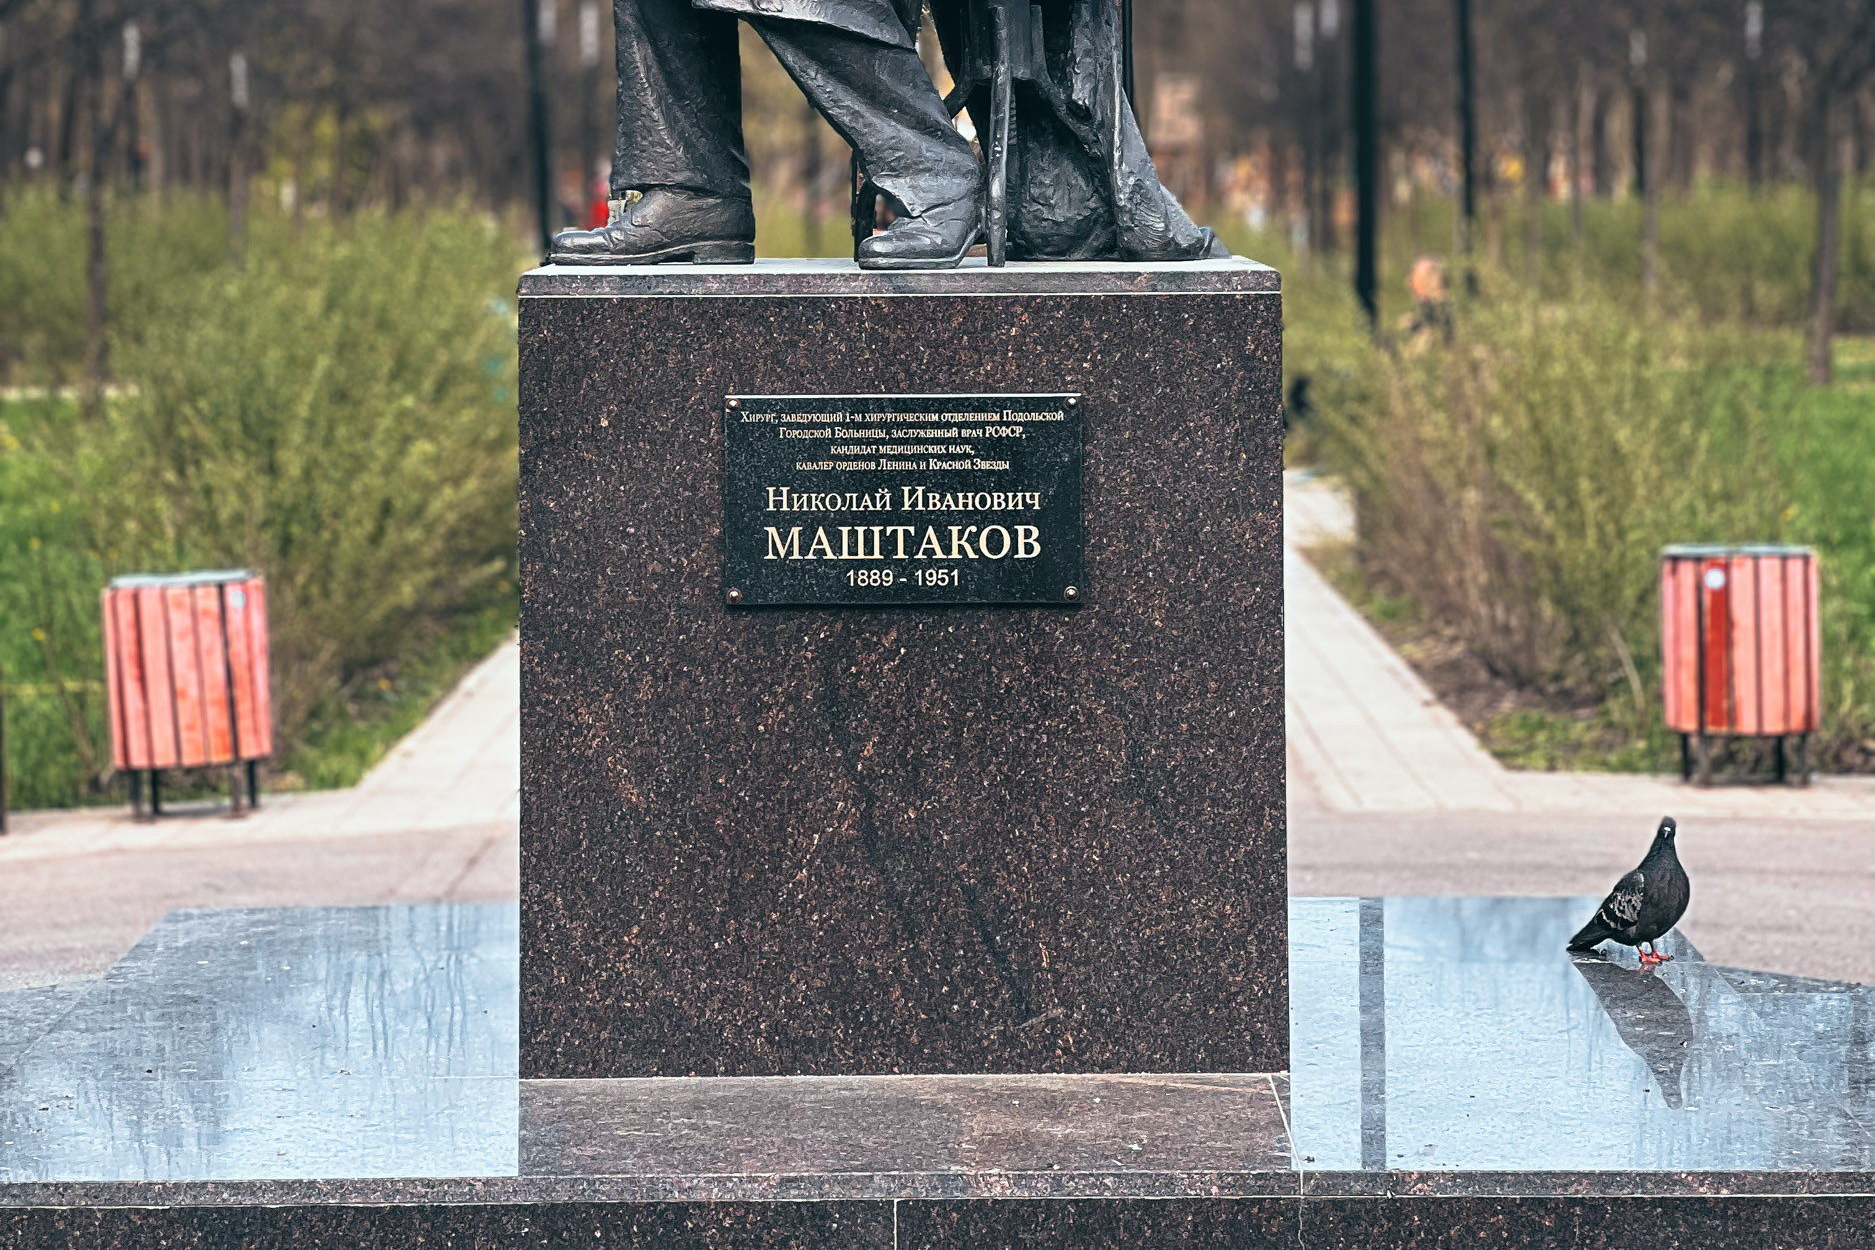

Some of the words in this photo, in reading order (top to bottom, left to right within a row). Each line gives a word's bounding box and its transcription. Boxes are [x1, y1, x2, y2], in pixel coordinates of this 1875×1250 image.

[985, 426, 1026, 439] РСФСР,
[763, 525, 1042, 560] МАШТАКОВ
[847, 570, 894, 587] 1889
[914, 569, 960, 586] 1951
